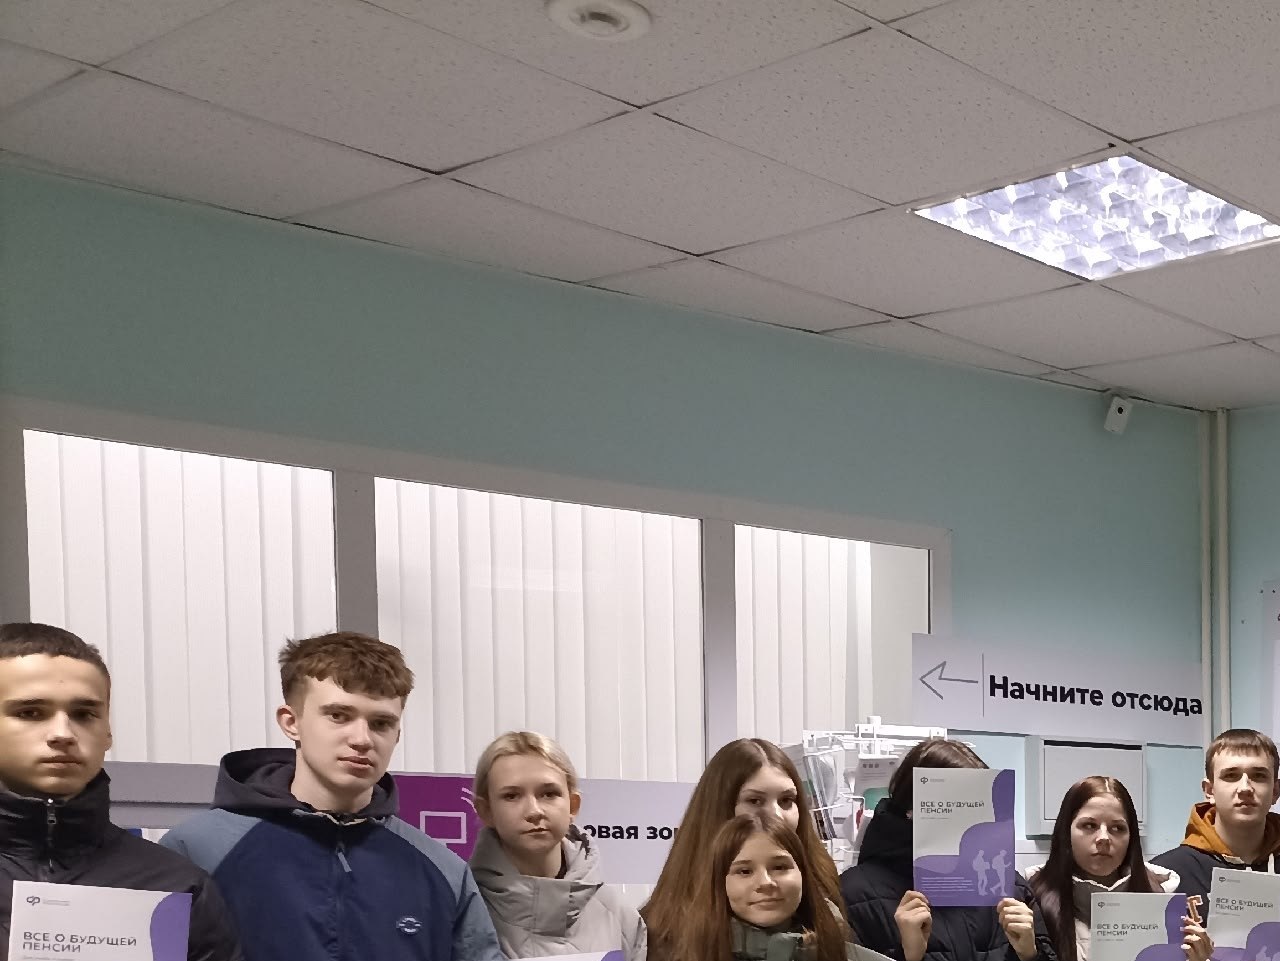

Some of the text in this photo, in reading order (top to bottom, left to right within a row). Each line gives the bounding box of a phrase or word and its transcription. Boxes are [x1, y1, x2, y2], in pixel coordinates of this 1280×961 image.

[989, 674, 1203, 716] Начните отсюда
[583, 824, 678, 840] овая зо
[24, 931, 137, 946] ВСЕ О БУДУЩЕЙ
[23, 942, 81, 953] ПЕНСИИ
